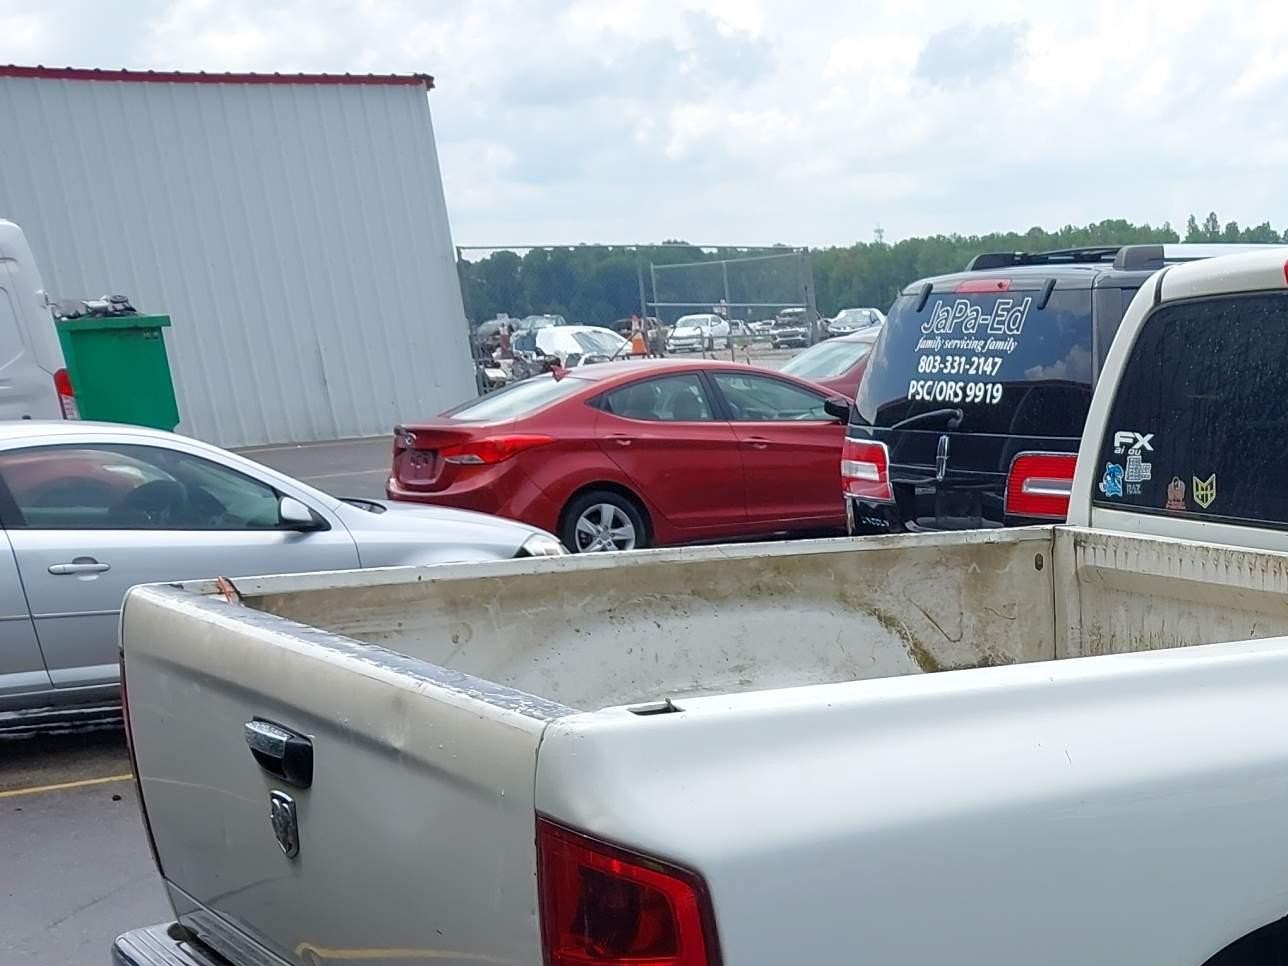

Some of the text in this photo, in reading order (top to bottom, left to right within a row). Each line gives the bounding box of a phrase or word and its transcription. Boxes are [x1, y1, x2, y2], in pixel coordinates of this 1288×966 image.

[920, 297, 1032, 335] JaPa-Ed
[914, 337, 1018, 354] family servicing family
[917, 355, 1002, 377] 803-331-2147
[907, 380, 1003, 404] PSC/ORS 9919
[1113, 430, 1155, 452] FX
